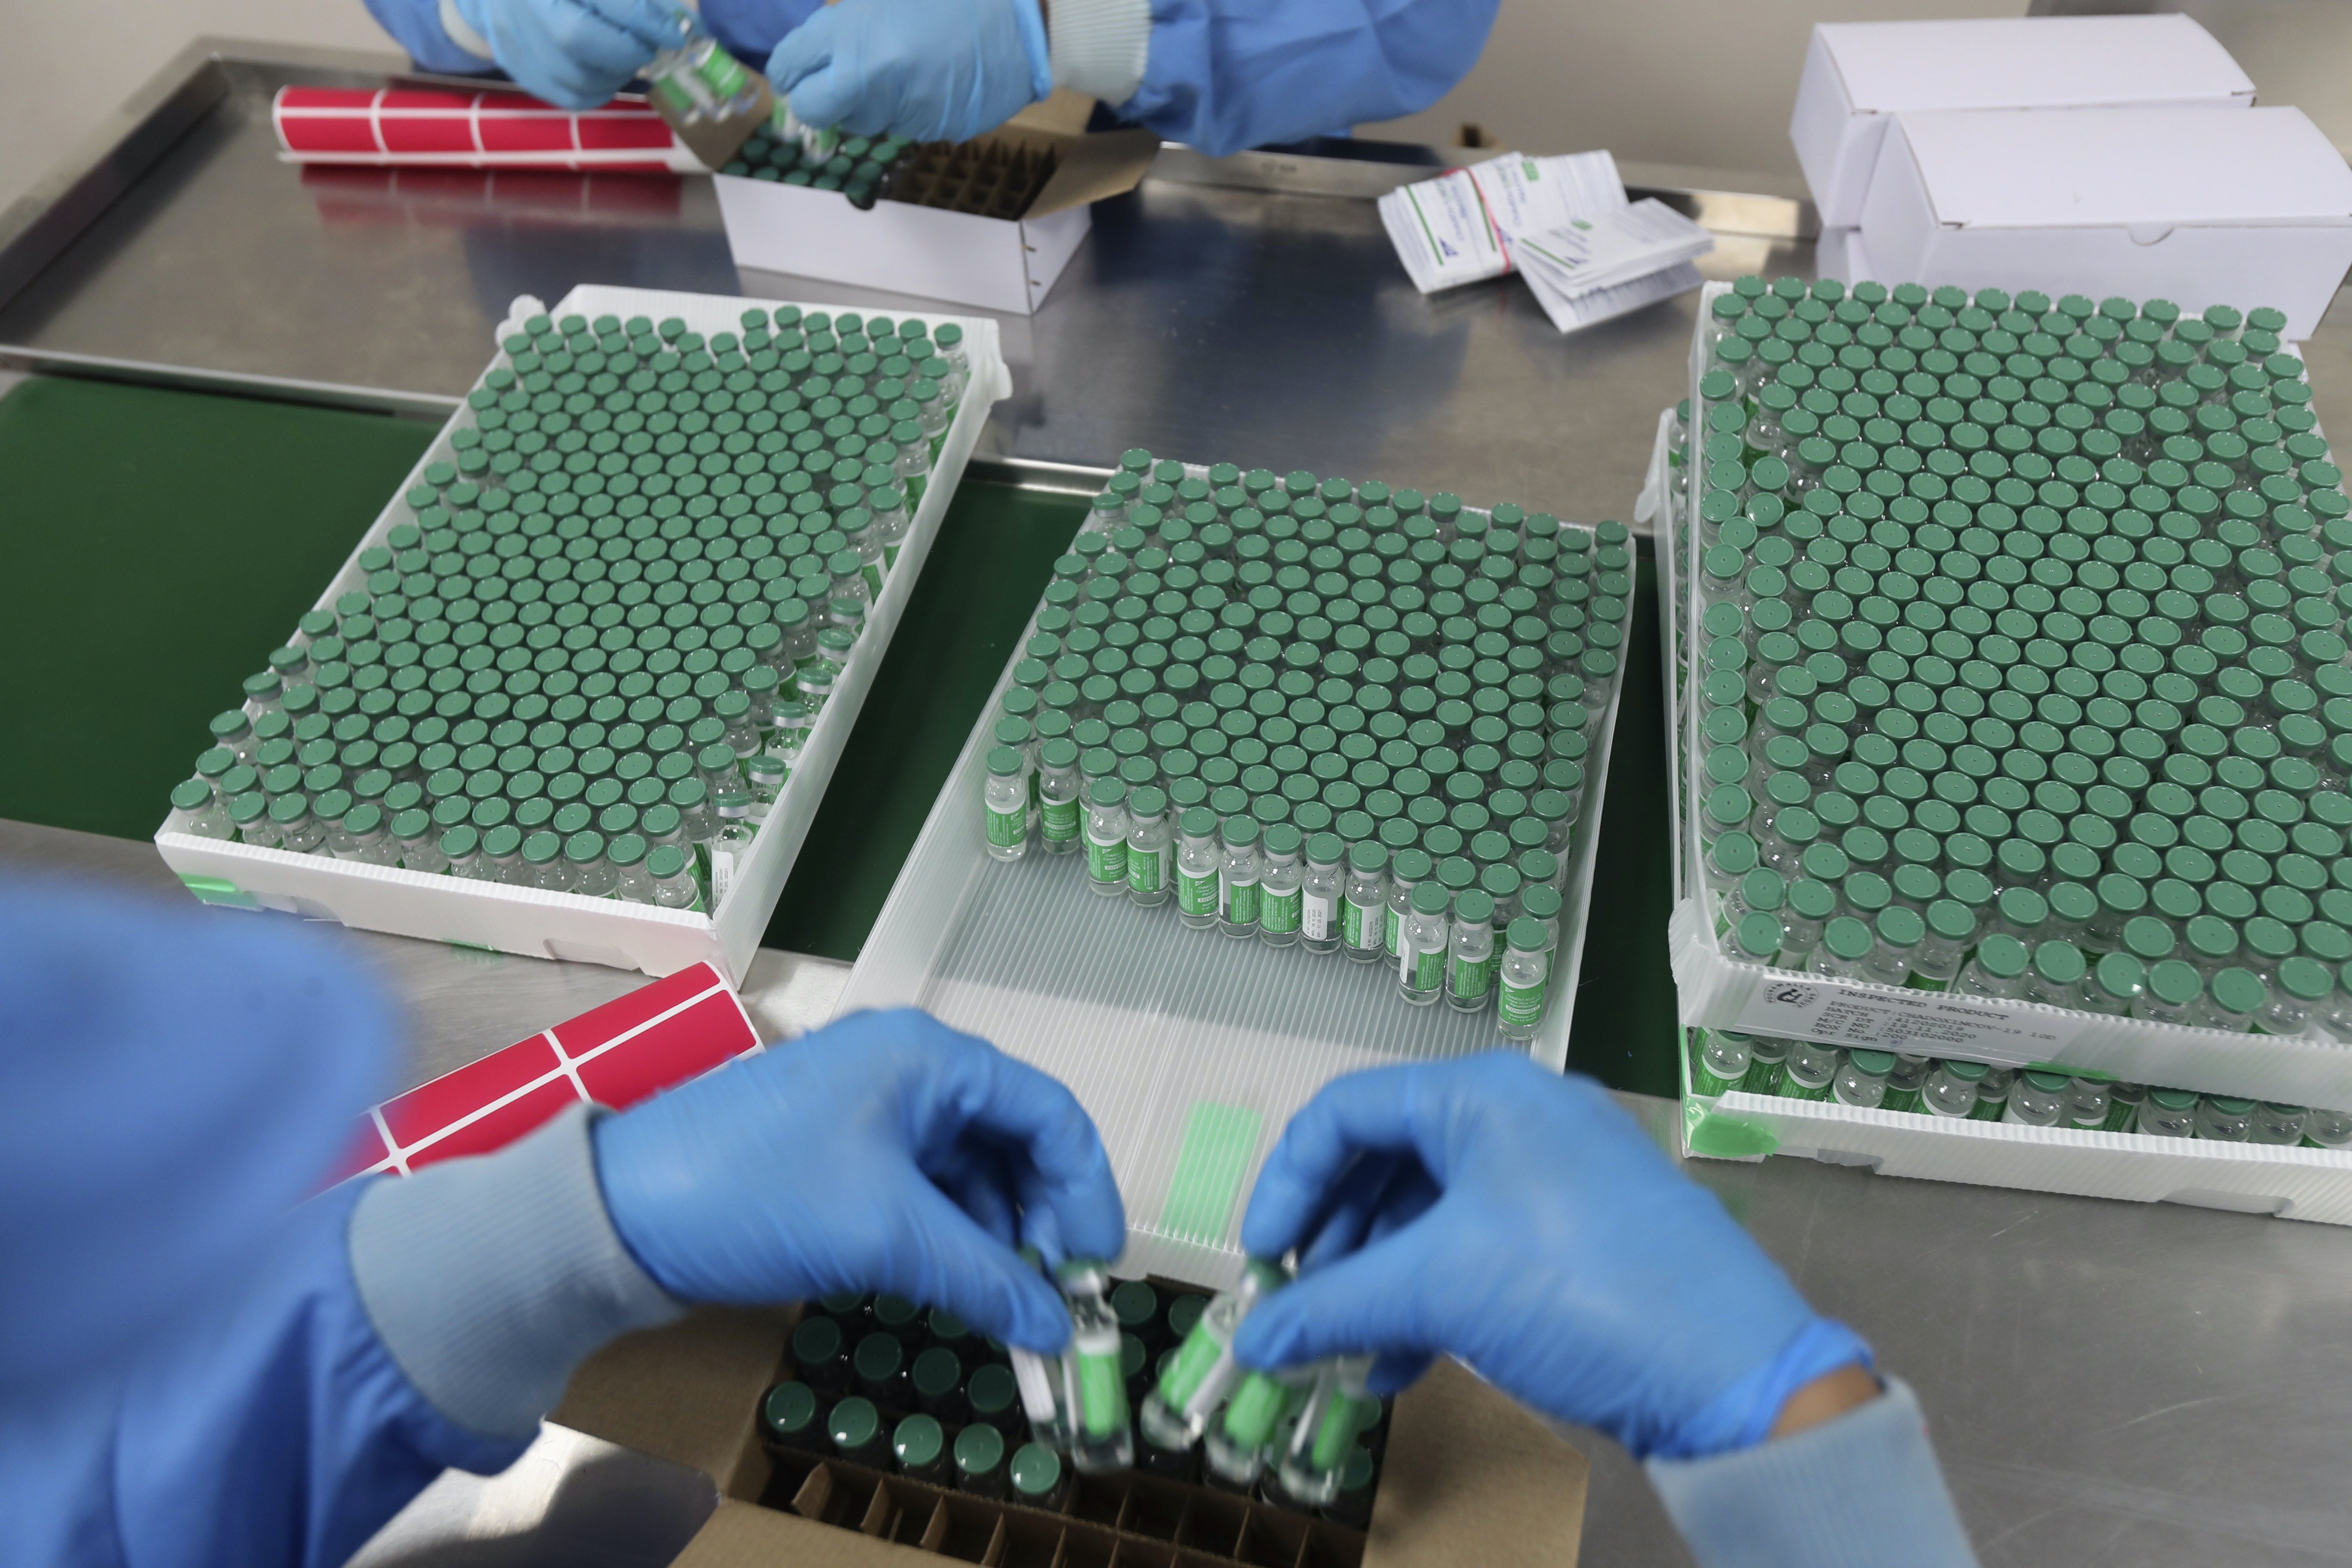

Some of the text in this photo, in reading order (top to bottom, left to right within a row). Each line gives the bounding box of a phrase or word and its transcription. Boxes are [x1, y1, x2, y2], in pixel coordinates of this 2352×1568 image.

[1838, 989, 2009, 1020] INSPECTED PRODUCT
[1822, 1012, 1849, 1020] SCR
[1825, 1006, 1869, 1017] BATCH
[1814, 1022, 1841, 1030] BOX
[1811, 1028, 1878, 1042] Opr Sign
[2029, 1032, 2057, 1040] 10D
